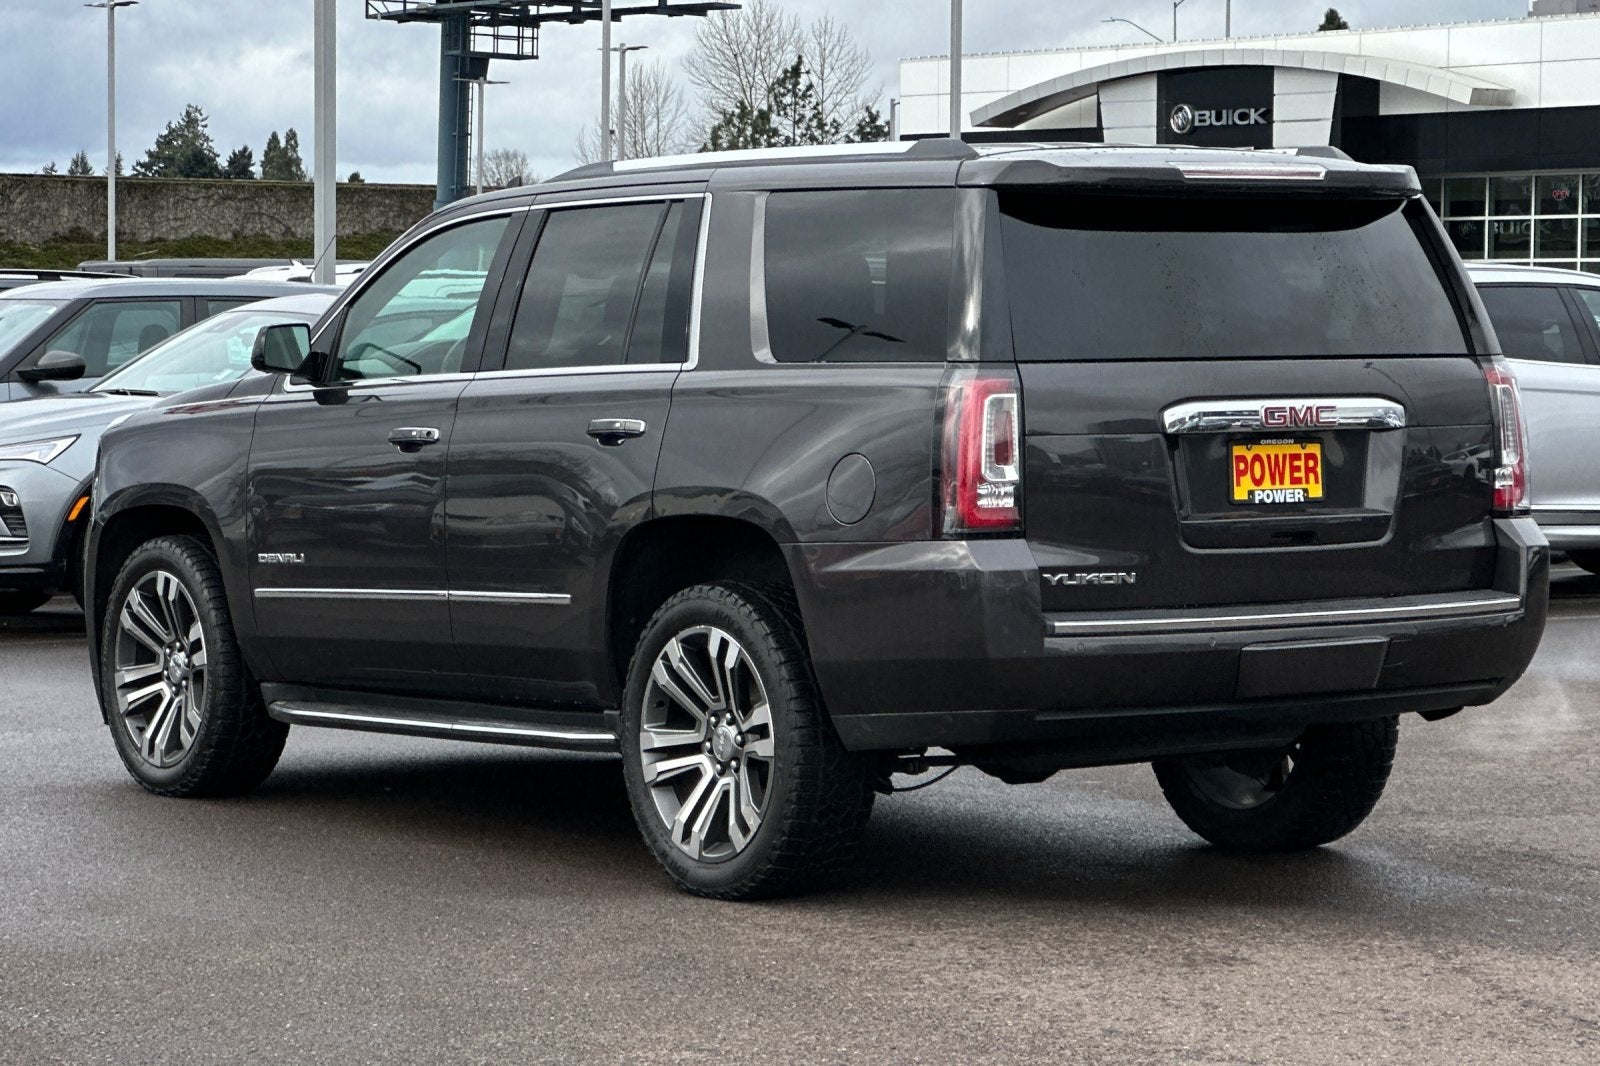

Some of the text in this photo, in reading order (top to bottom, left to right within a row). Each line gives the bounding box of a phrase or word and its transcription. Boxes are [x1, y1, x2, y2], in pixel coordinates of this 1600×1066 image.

[1194, 108, 1267, 126] BUICK
[1261, 405, 1338, 427] GMC
[1234, 452, 1320, 487] POWER
[1254, 488, 1304, 504] POWER
[257, 553, 305, 563] DENALI
[1042, 573, 1136, 586] YUKON
